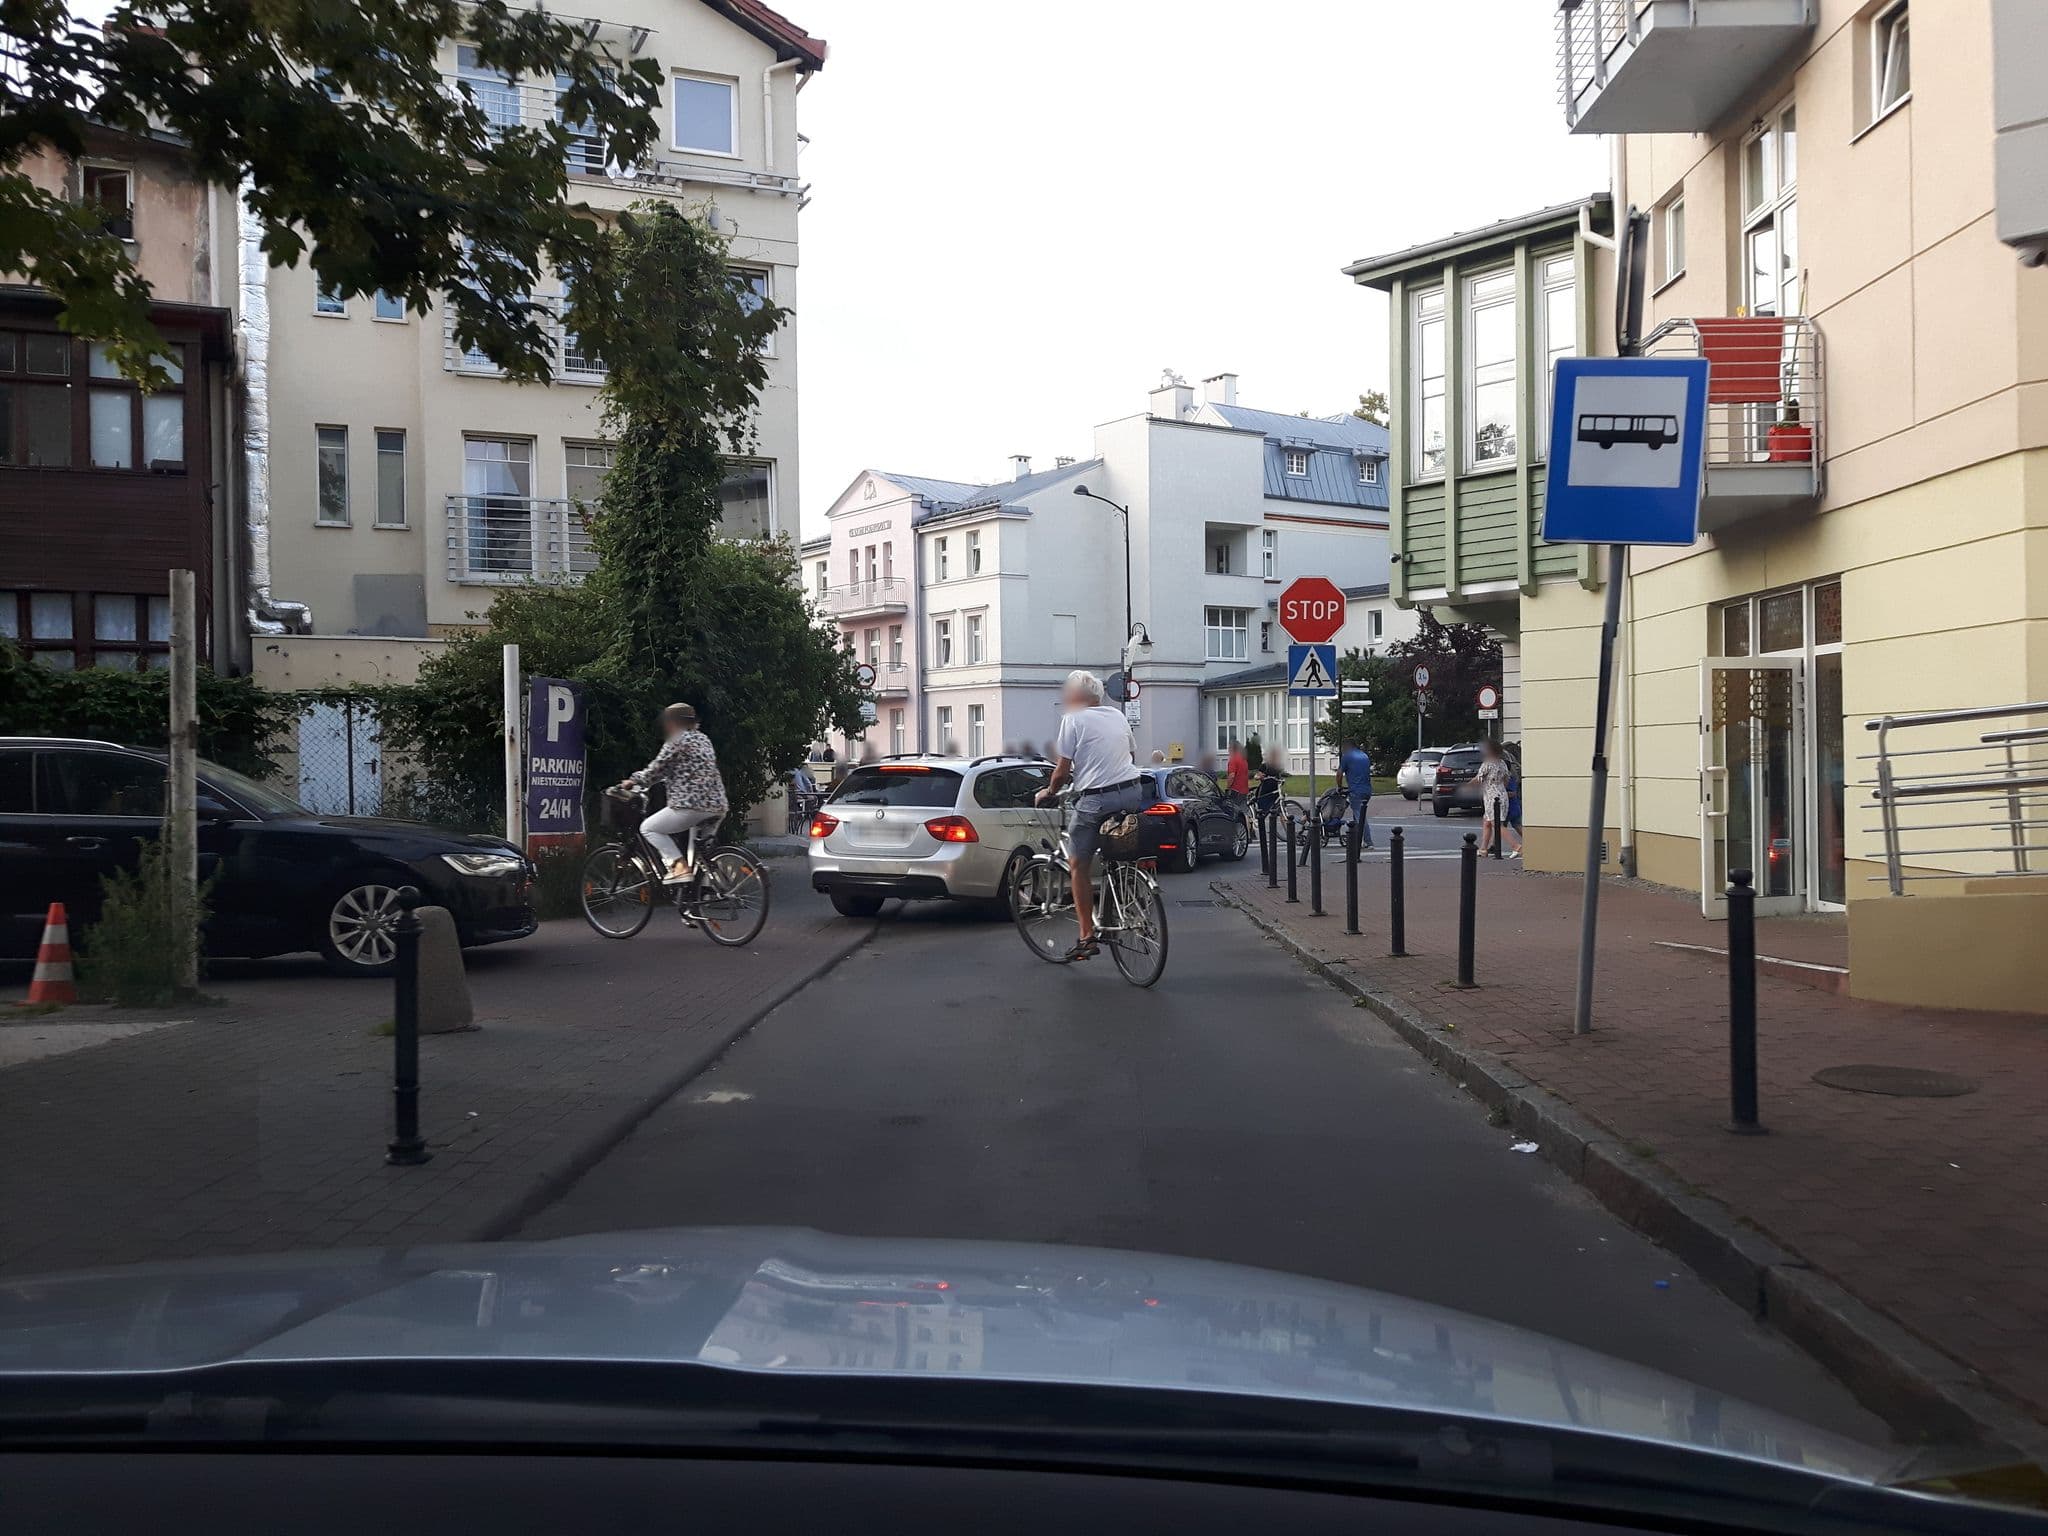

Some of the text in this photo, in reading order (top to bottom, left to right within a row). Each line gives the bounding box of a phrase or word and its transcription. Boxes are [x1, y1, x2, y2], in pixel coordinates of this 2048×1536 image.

[1286, 600, 1339, 620] STOP
[547, 685, 575, 742] P
[532, 757, 583, 775] PARKING
[531, 776, 581, 787] NIESTRZEŻONY
[539, 798, 572, 819] 24/H
